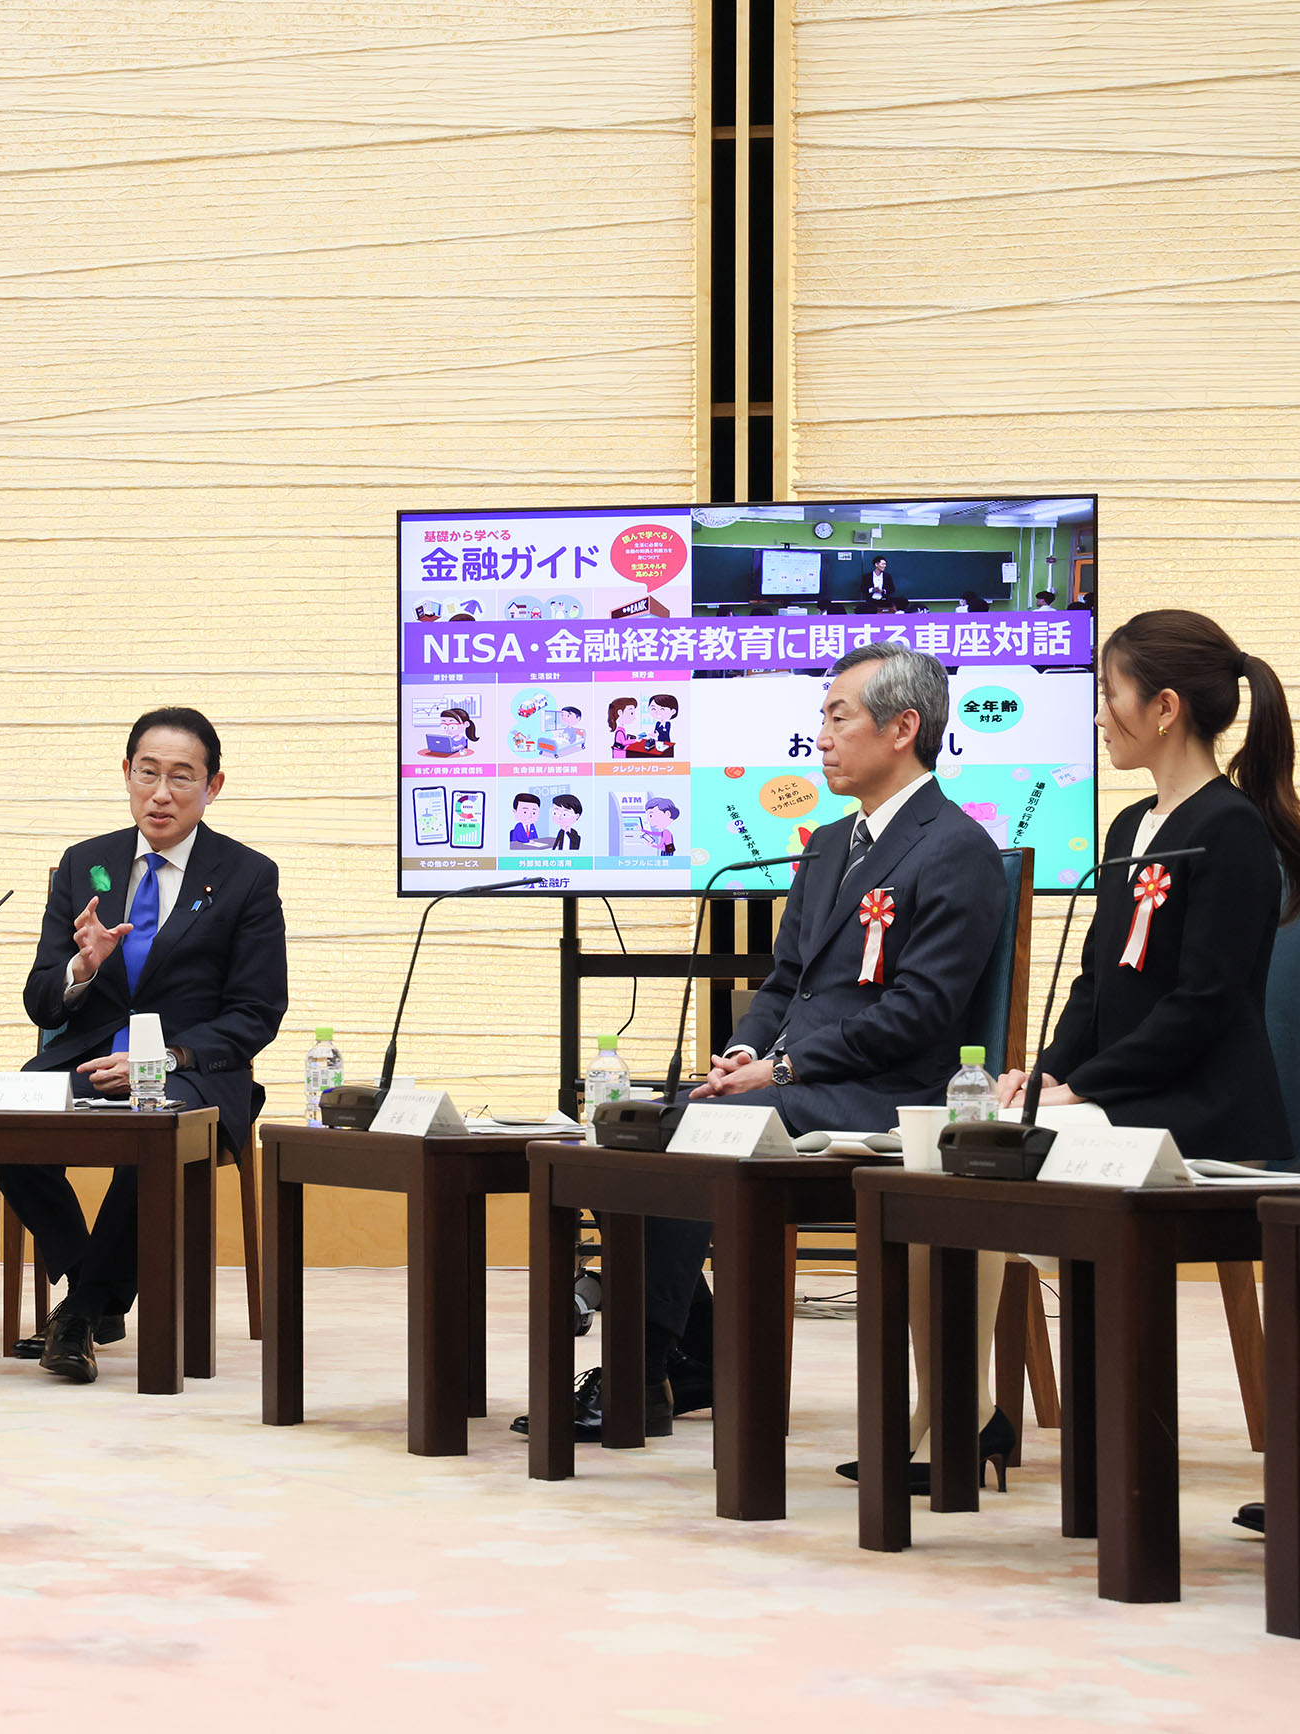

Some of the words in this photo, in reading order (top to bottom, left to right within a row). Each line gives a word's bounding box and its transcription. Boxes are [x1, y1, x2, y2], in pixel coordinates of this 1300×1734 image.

[424, 530, 511, 543] 基礎から学べる
[421, 545, 599, 582] 金融ガイド
[423, 619, 1071, 664] NISA・金融経済教育に関する車座対話
[530, 672, 560, 681] 生活設計
[964, 700, 1018, 713] 全年齢
[979, 714, 1003, 723] 対応
[612, 765, 675, 773] クレジット/ローン
[622, 796, 642, 804] ATM
[1012, 781, 1046, 848] 場面別の行動をし
[419, 859, 480, 868] その他のサービス
[617, 859, 669, 867] トラブルに注意
[539, 877, 571, 888] 金融庁
